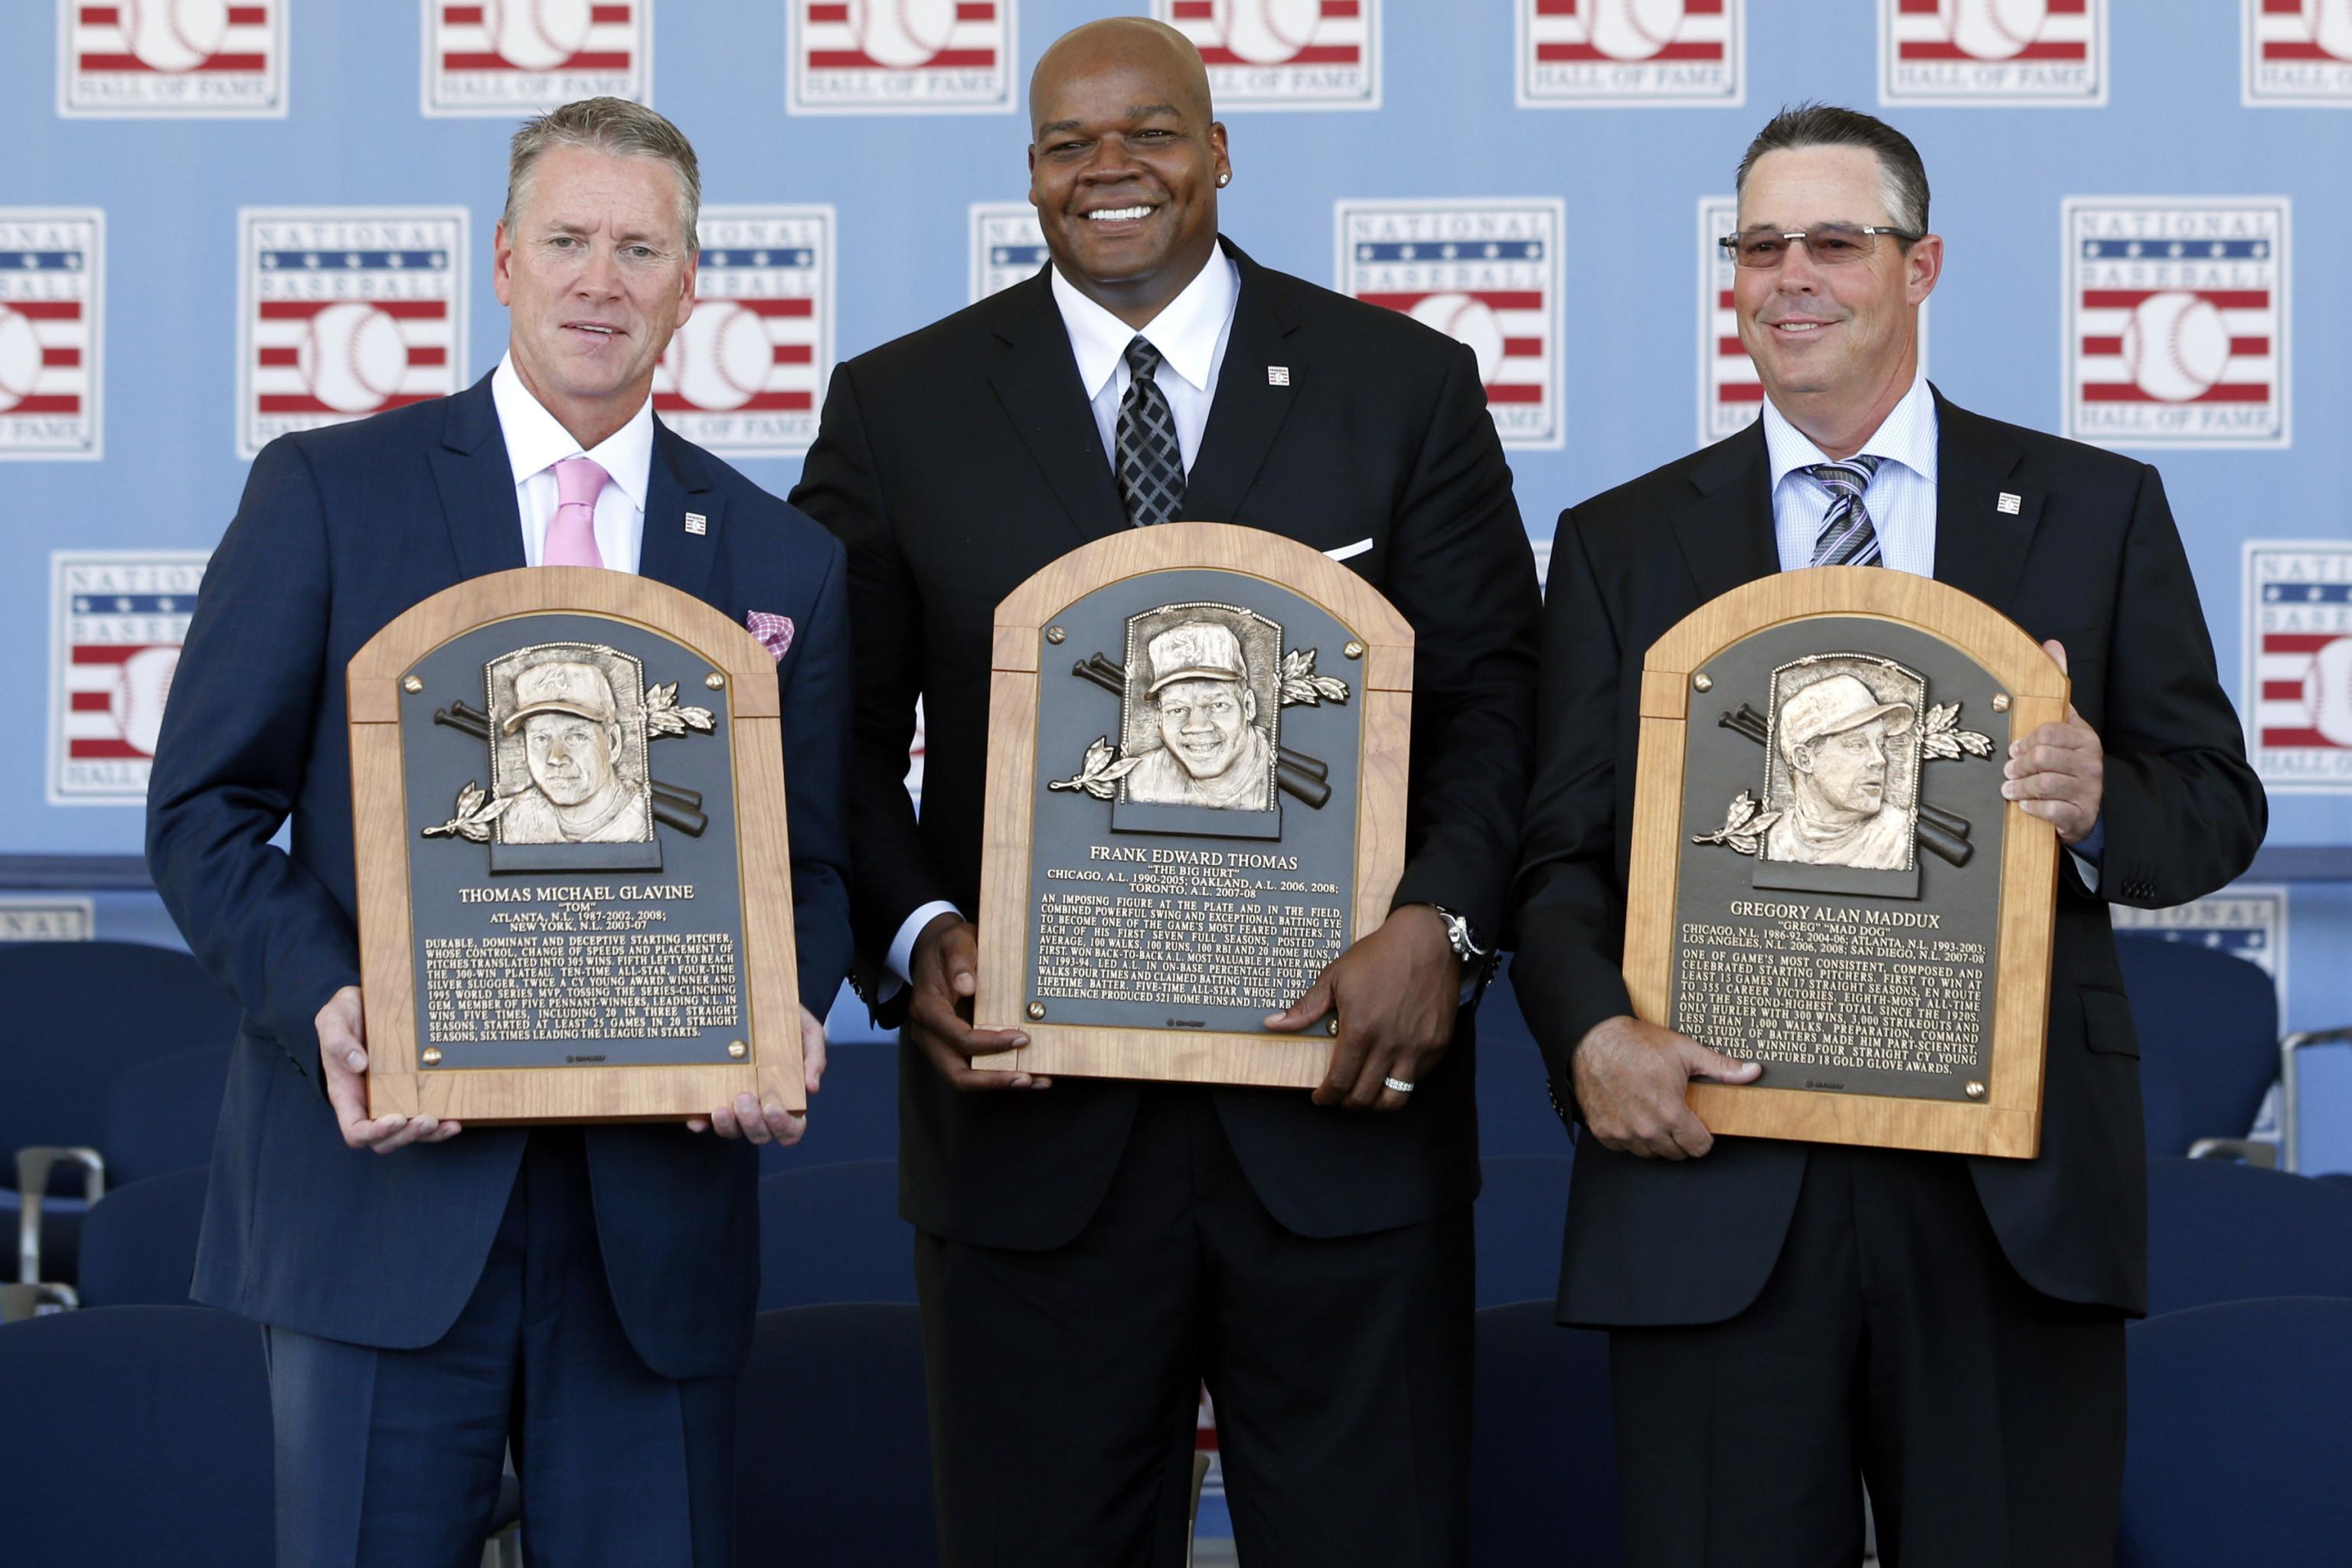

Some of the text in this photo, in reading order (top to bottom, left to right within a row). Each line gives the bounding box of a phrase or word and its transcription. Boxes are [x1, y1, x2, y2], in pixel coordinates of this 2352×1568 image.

[259, 225, 447, 247] NATIONAL
[1354, 217, 1544, 240] NATIONAL
[2081, 215, 2270, 237] NATIONAL
[259, 276, 447, 299] BASEBALL
[1354, 268, 1543, 290] BASEBALL
[2081, 266, 2270, 288] BASEBALL
[1090, 846, 1298, 870] FRANK EDWARD THOMAS
[1047, 869, 1338, 893] CHICAGO, A.L. 1990-2005; OAKLAND, A.L. 2006, 2008;
[1179, 866, 1200, 876] BIG
[458, 884, 694, 903] THOMAS MICHAEL GLAVINE
[1129, 883, 1256, 899] TORONTO, A.L. 2007-08
[1040, 903, 1342, 929] COMBINED POWERFUL SWING AND EXCEPTIONAL BATTING EYE
[1041, 893, 1055, 903] AN
[1062, 894, 1109, 906] IMPOSING
[1116, 897, 1153, 908] FIGURE
[1159, 899, 1170, 909] AT
[1177, 900, 1197, 910] THE
[1203, 901, 1234, 913] PLATE
[1240, 903, 1261, 913] AND
[1267, 904, 1279, 915] IN
[1284, 905, 1304, 916] THE
[1730, 901, 1940, 929] GREGORY ALAN MADDUX
[489, 910, 666, 923] ATLANTA, N.L. 1987-2002, 2008;
[510, 920, 647, 932] NEW YORK, N.L. 2003-07
[1041, 913, 1054, 923] TO
[1058, 914, 1096, 926] BECOME
[1101, 916, 1122, 927] ONE
[1125, 918, 1138, 928] OF
[1144, 919, 1162, 929] THE
[1207, 922, 1234, 933] MOST
[1239, 923, 1277, 936] FEARED
[1330, 929, 1341, 939] IN
[482, 936, 537, 947] DOMINANT
[541, 936, 564, 946] AND
[568, 935, 626, 946] DECEPTIVE
[630, 934, 681, 945] STARTING
[1682, 924, 1986, 954] CHICAGO, N.L. 1986-92, 2004-06; ATLANTA, N.L. 1993-2003;
[1682, 934, 1985, 964] LOS ANGELES, N.L. 2006, 2008; SAN DIEGO, N.L. 2007-08
[425, 948, 462, 959] WHOSE
[521, 946, 564, 957] CHANGE
[568, 946, 582, 956] OF
[586, 945, 625, 956] SPEEDS
[628, 945, 651, 955] AND
[655, 944, 714, 955] PLACEMENT
[719, 943, 733, 953] OF
[1681, 959, 1753, 974] CELEBRATED
[1758, 964, 1813, 978] STARTING
[1883, 973, 1916, 985] FIRST
[1919, 975, 1936, 987] TO
[1940, 977, 1962, 988] WIN
[1968, 979, 1982, 990] AT
[1682, 949, 1705, 959] ONE
[1710, 950, 1726, 961] OF
[1779, 955, 1810, 967] MOST
[1892, 963, 1954, 977] COMPOSED
[1958, 968, 1983, 979] AND
[479, 1030, 498, 1040] SIX
[498, 1029, 531, 1040] TIMES
[532, 1028, 579, 1040] LEADING
[580, 1028, 602, 1039] THE
[603, 1027, 645, 1038] LEAGUE
[646, 1027, 658, 1037] IN
[1726, 1047, 1753, 1059] ALSO
[1755, 1049, 1815, 1064] CAPTURED
[1832, 1055, 1864, 1068] GOLD
[1866, 1057, 1903, 1071] GLOVE
